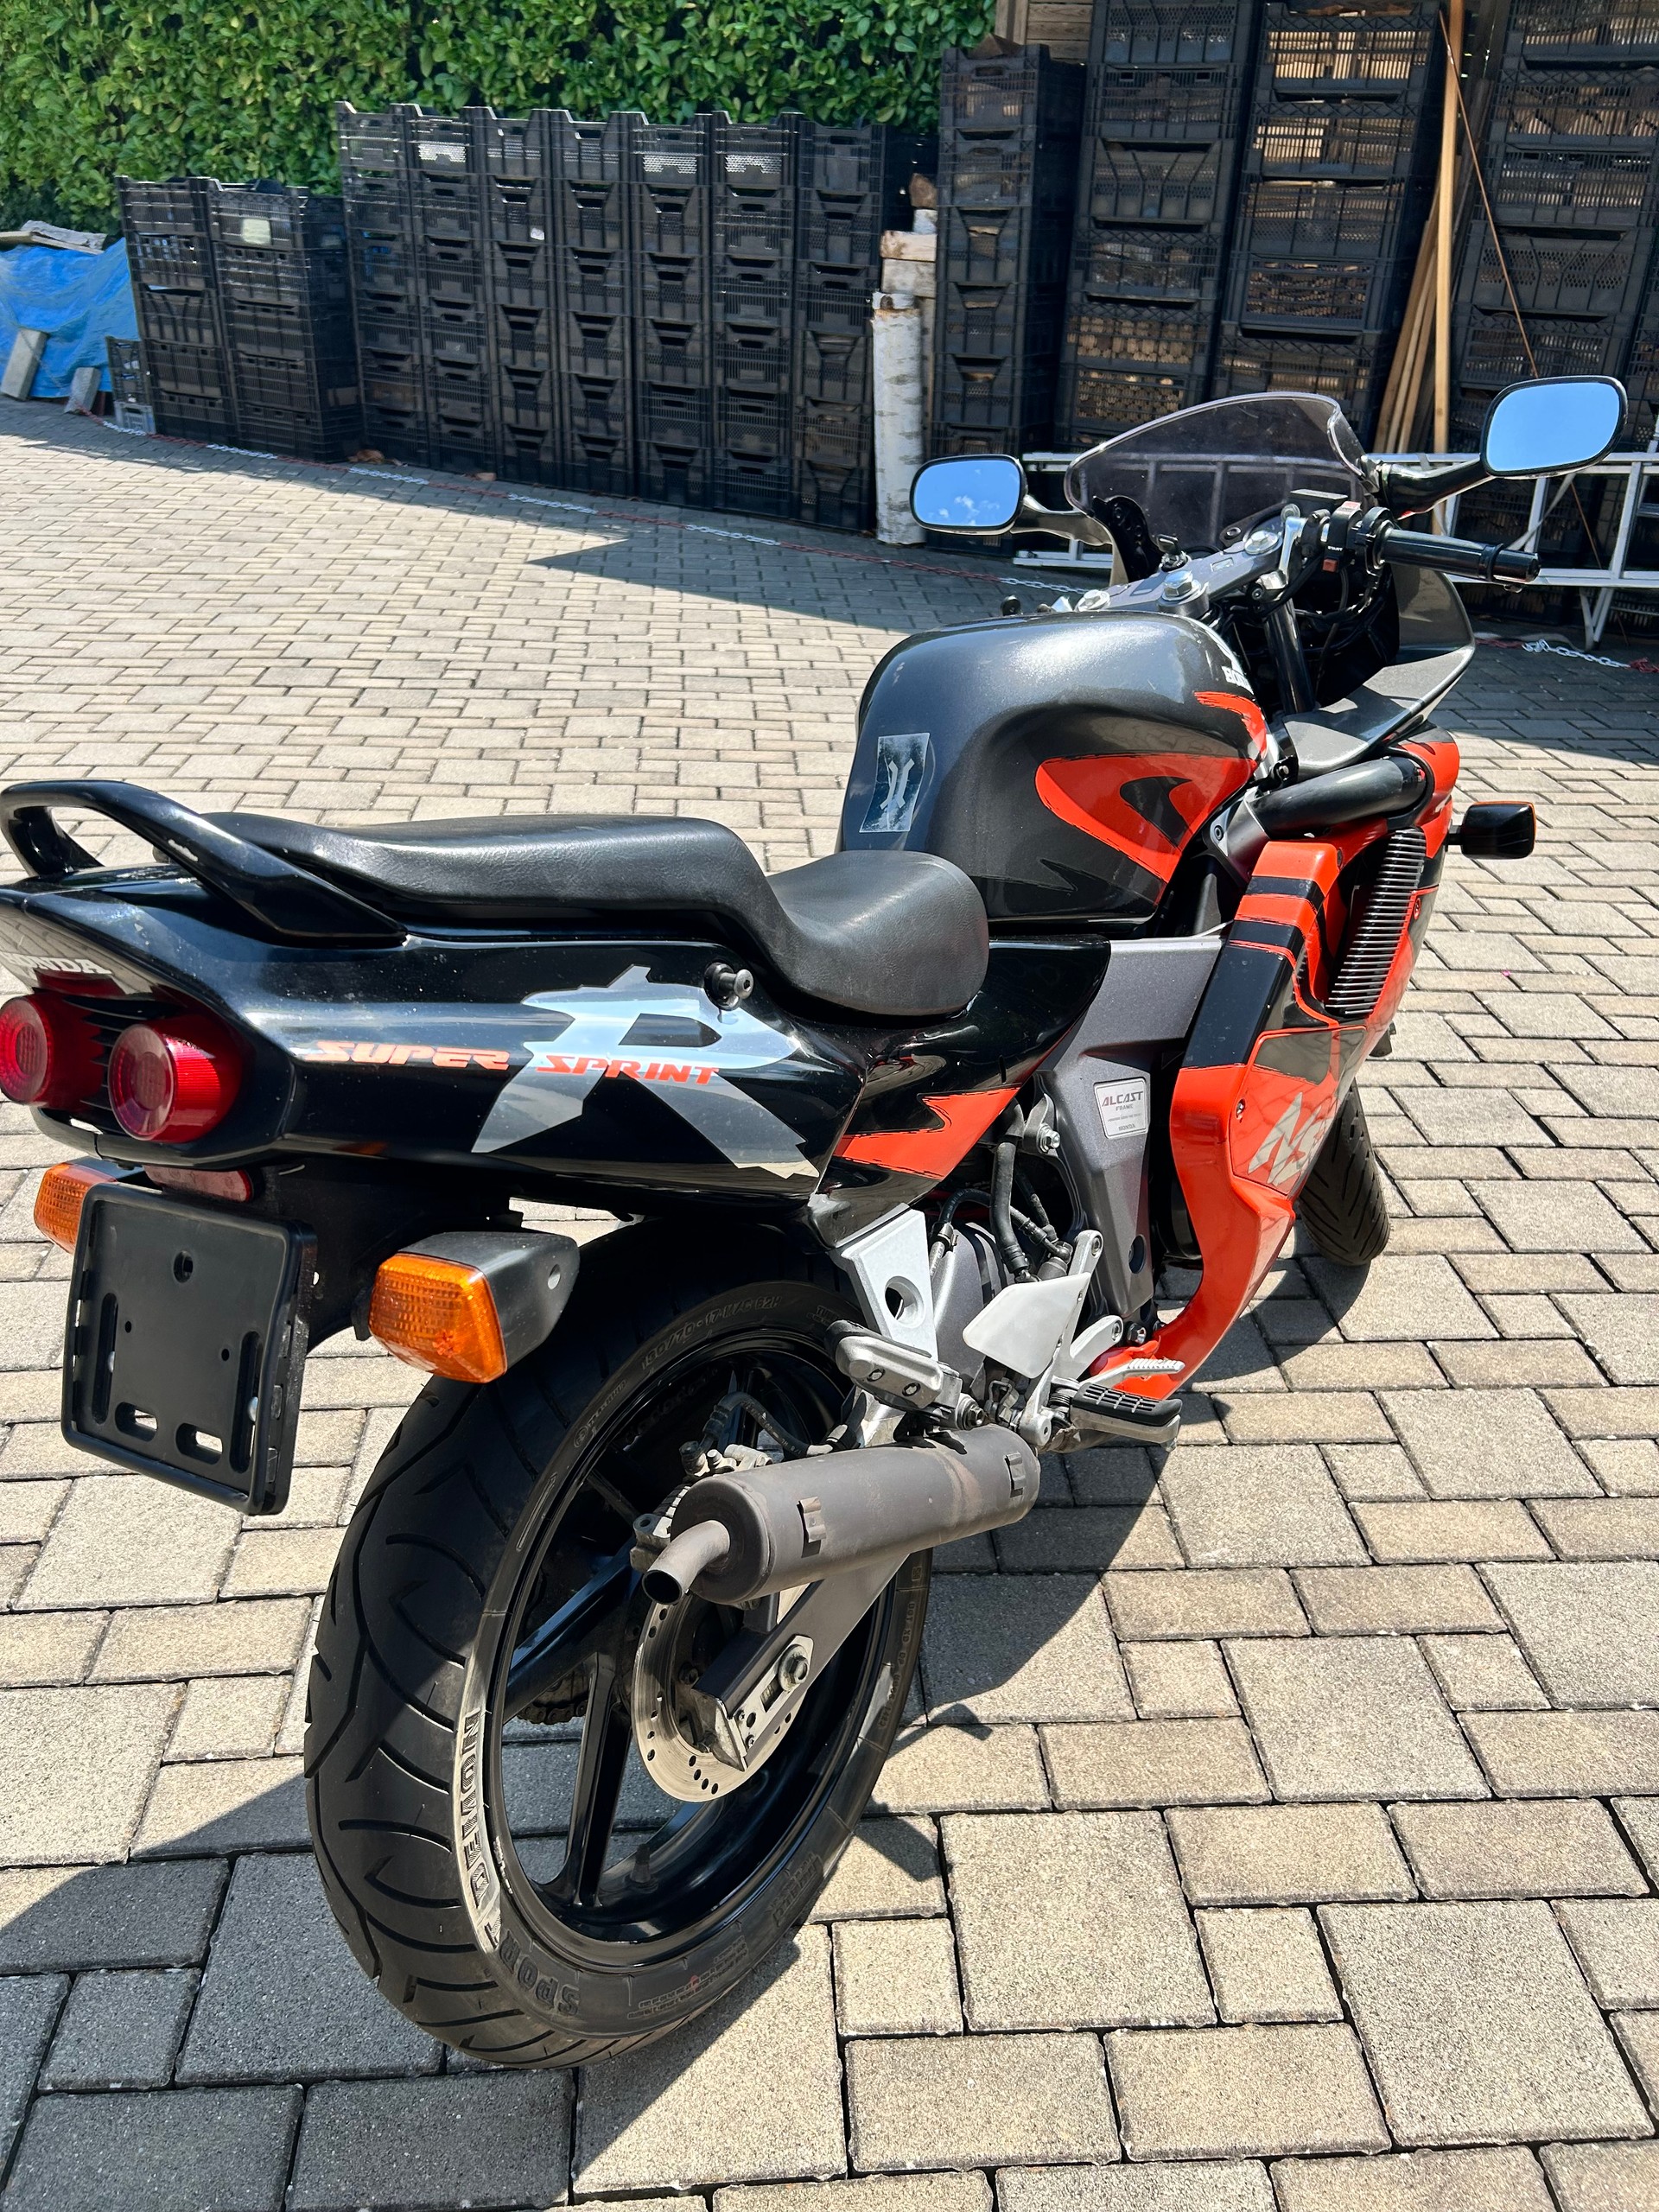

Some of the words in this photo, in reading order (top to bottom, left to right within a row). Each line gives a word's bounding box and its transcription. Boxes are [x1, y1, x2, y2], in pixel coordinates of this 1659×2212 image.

[304, 1040, 511, 1071] SUPER
[536, 1055, 719, 1085] SPRINT
[1102, 1090, 1144, 1107] ALCAST
[460, 1707, 491, 1910] DEMON
[484, 1908, 582, 2018] SPORT
